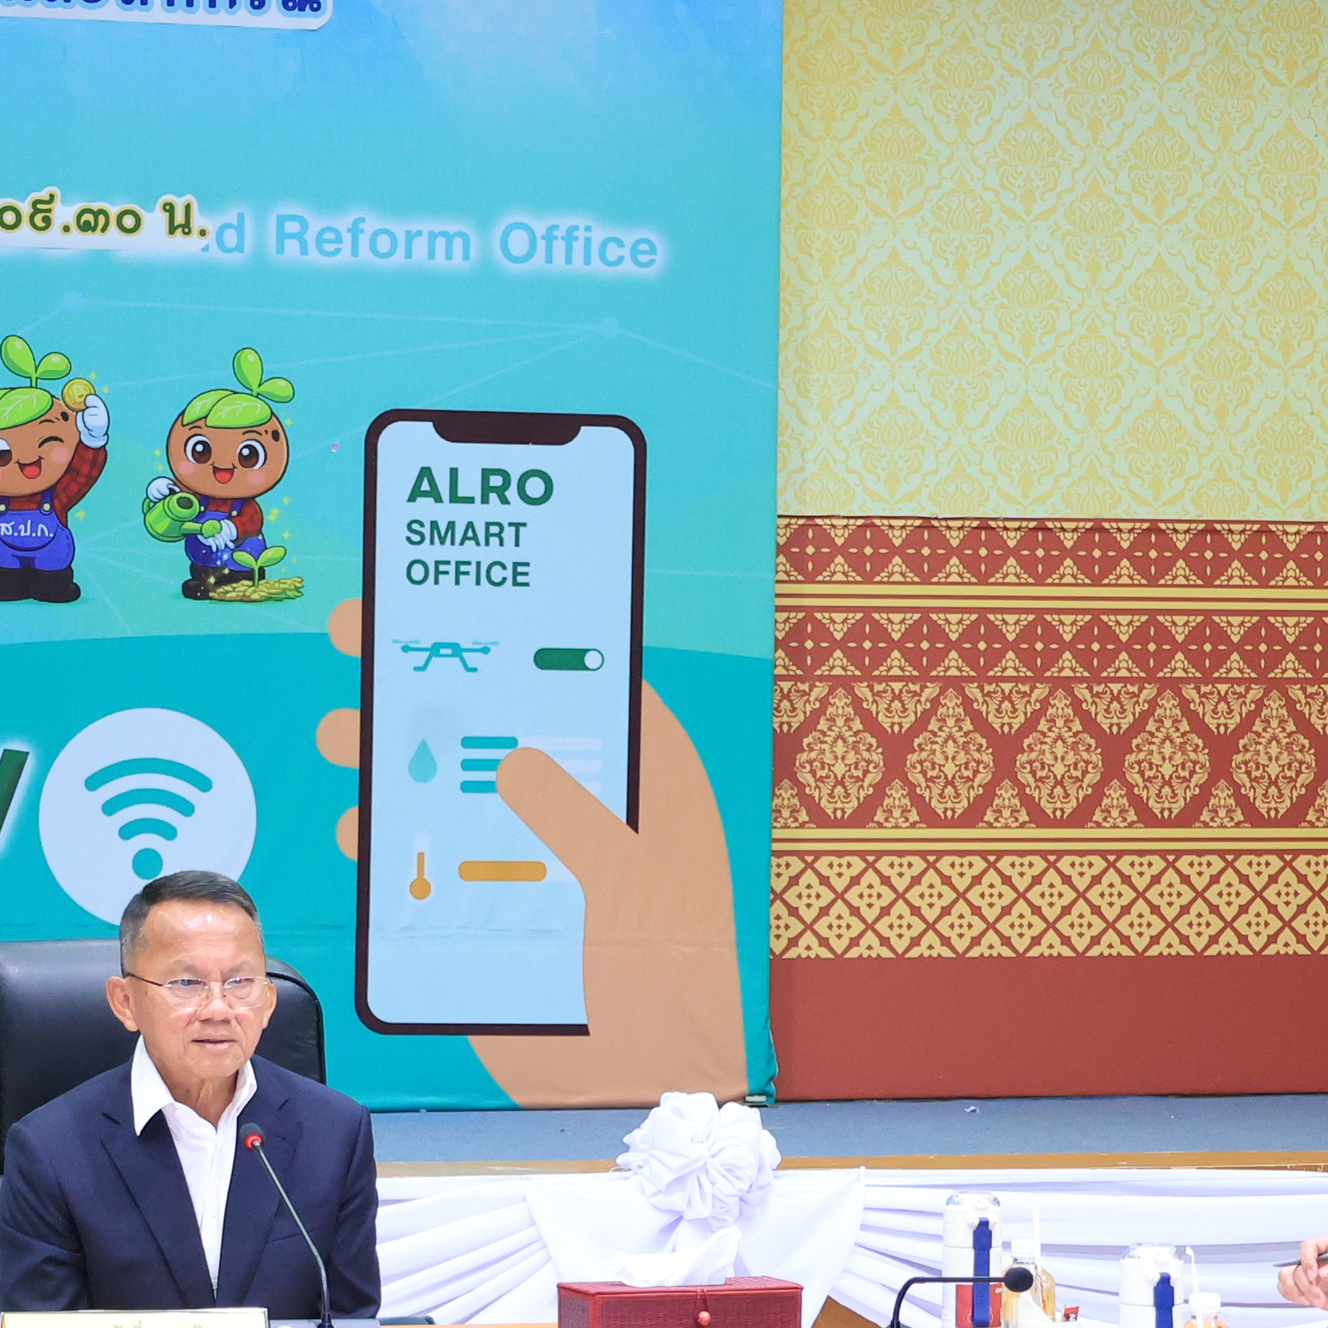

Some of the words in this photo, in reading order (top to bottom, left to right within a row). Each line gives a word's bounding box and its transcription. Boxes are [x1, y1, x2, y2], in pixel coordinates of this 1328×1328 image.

[162, 199, 210, 239] น.
[275, 213, 471, 262] Reform
[498, 220, 660, 269] Office
[406, 466, 554, 506] ALRO
[0, 519, 54, 537] ส.ป.ก.
[405, 519, 528, 548] SMART
[405, 559, 531, 588] OFFICE
